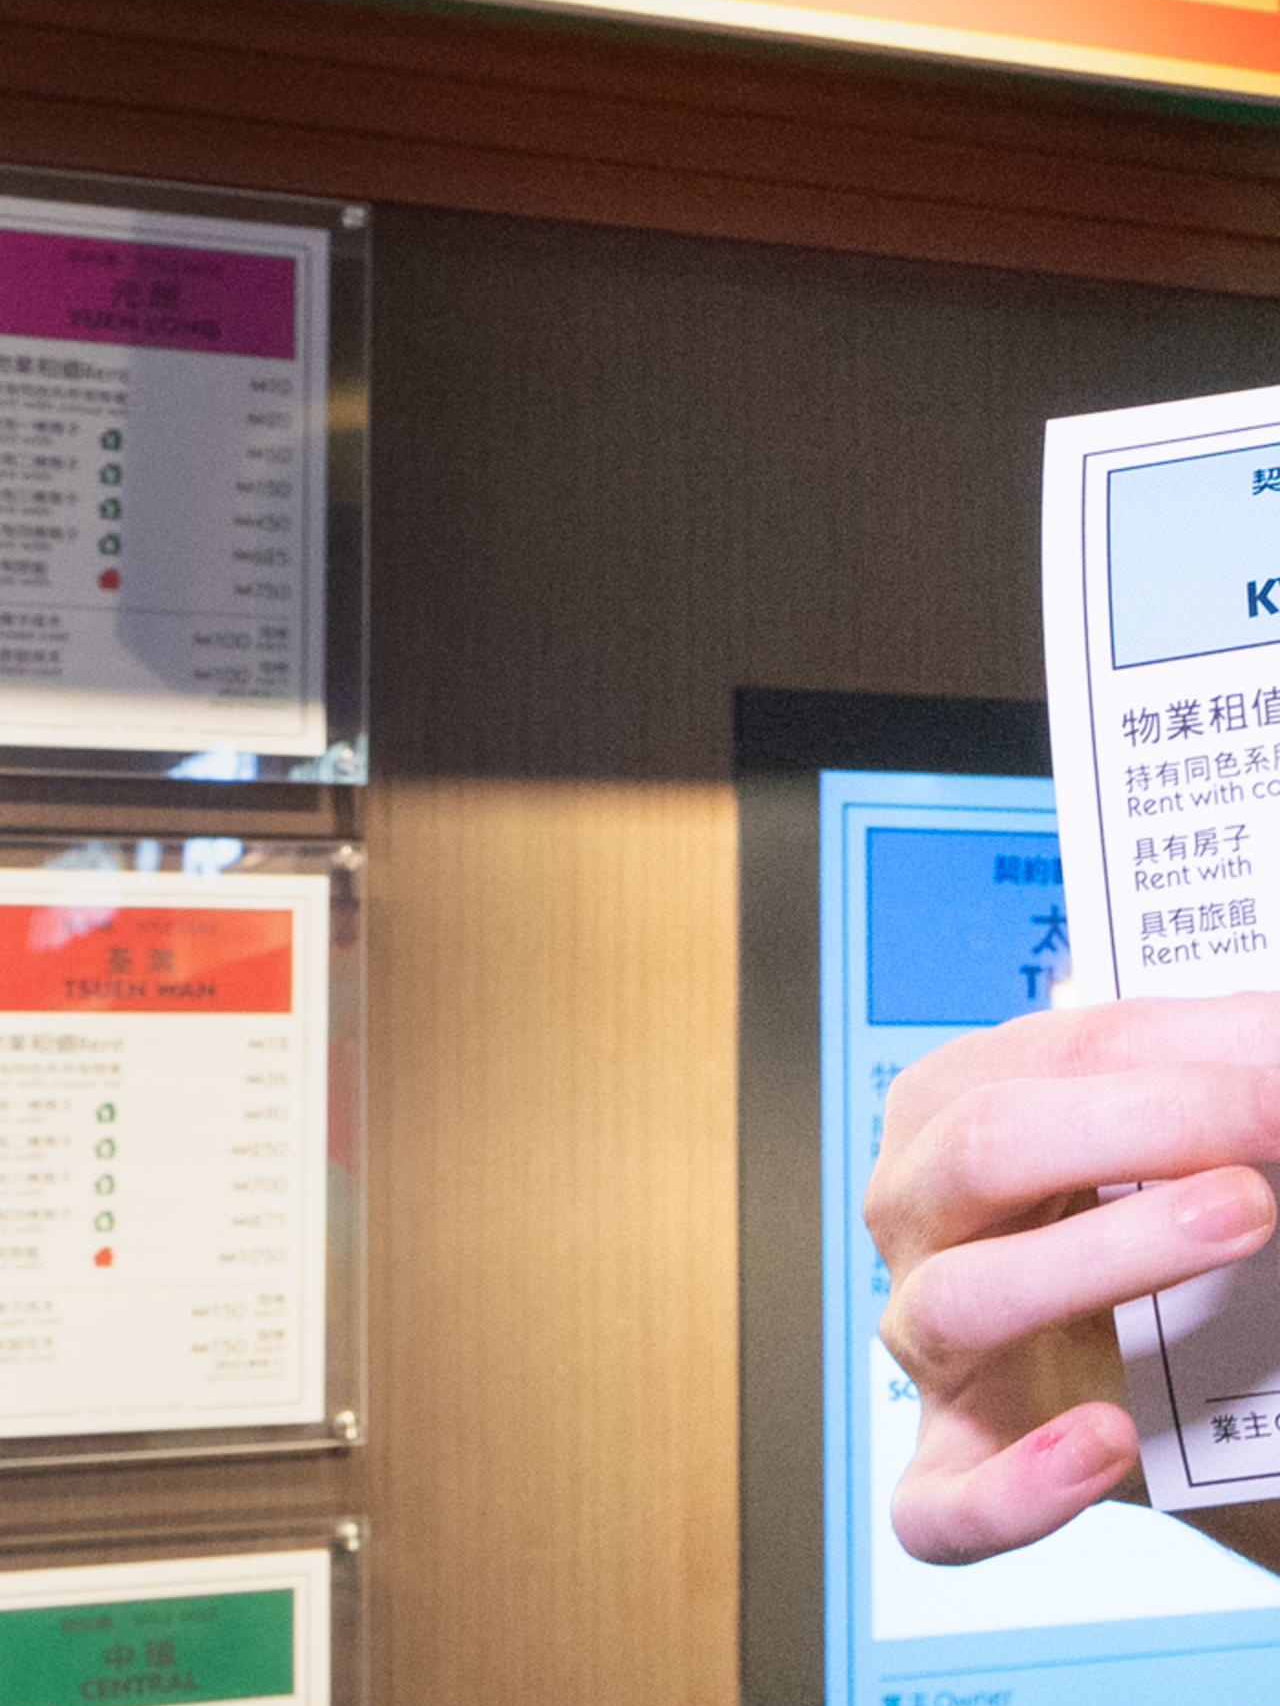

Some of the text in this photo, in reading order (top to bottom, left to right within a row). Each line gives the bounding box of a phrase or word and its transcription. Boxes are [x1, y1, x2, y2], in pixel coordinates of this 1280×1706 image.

[1127, 792, 1185, 819] Rent
[1189, 780, 1245, 808] with
[1133, 823, 1251, 867] 具有房子
[1134, 855, 1253, 893] Rent with
[1140, 896, 1258, 942] 具有旅館
[1141, 929, 1268, 968] Rent with
